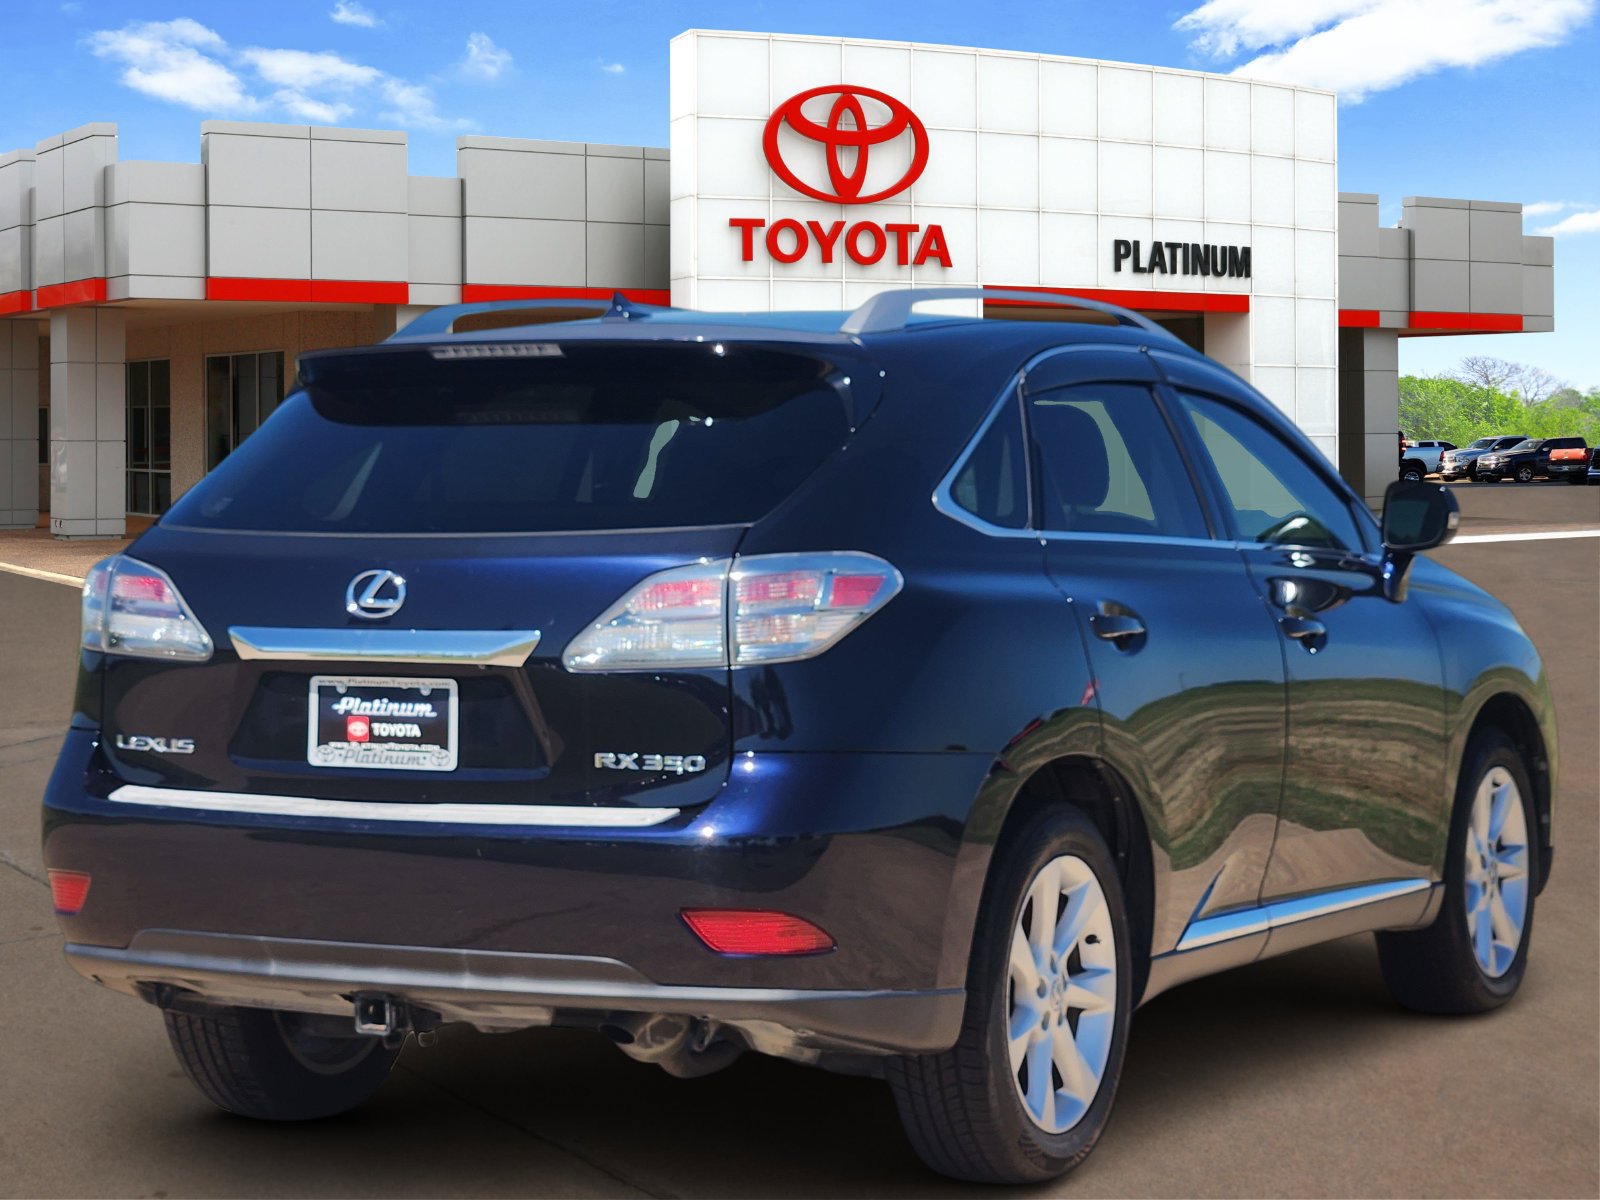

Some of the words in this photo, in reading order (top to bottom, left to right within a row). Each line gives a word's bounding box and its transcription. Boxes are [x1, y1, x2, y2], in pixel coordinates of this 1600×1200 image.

[729, 218, 953, 267] TOYOTA
[1113, 239, 1252, 278] PLATINUM
[331, 697, 437, 717] Platinum
[371, 722, 421, 737] TOYOTA
[116, 734, 195, 753] LEXUS
[342, 748, 425, 766] Platinum
[594, 752, 639, 770] RX
[642, 753, 706, 773] 350
